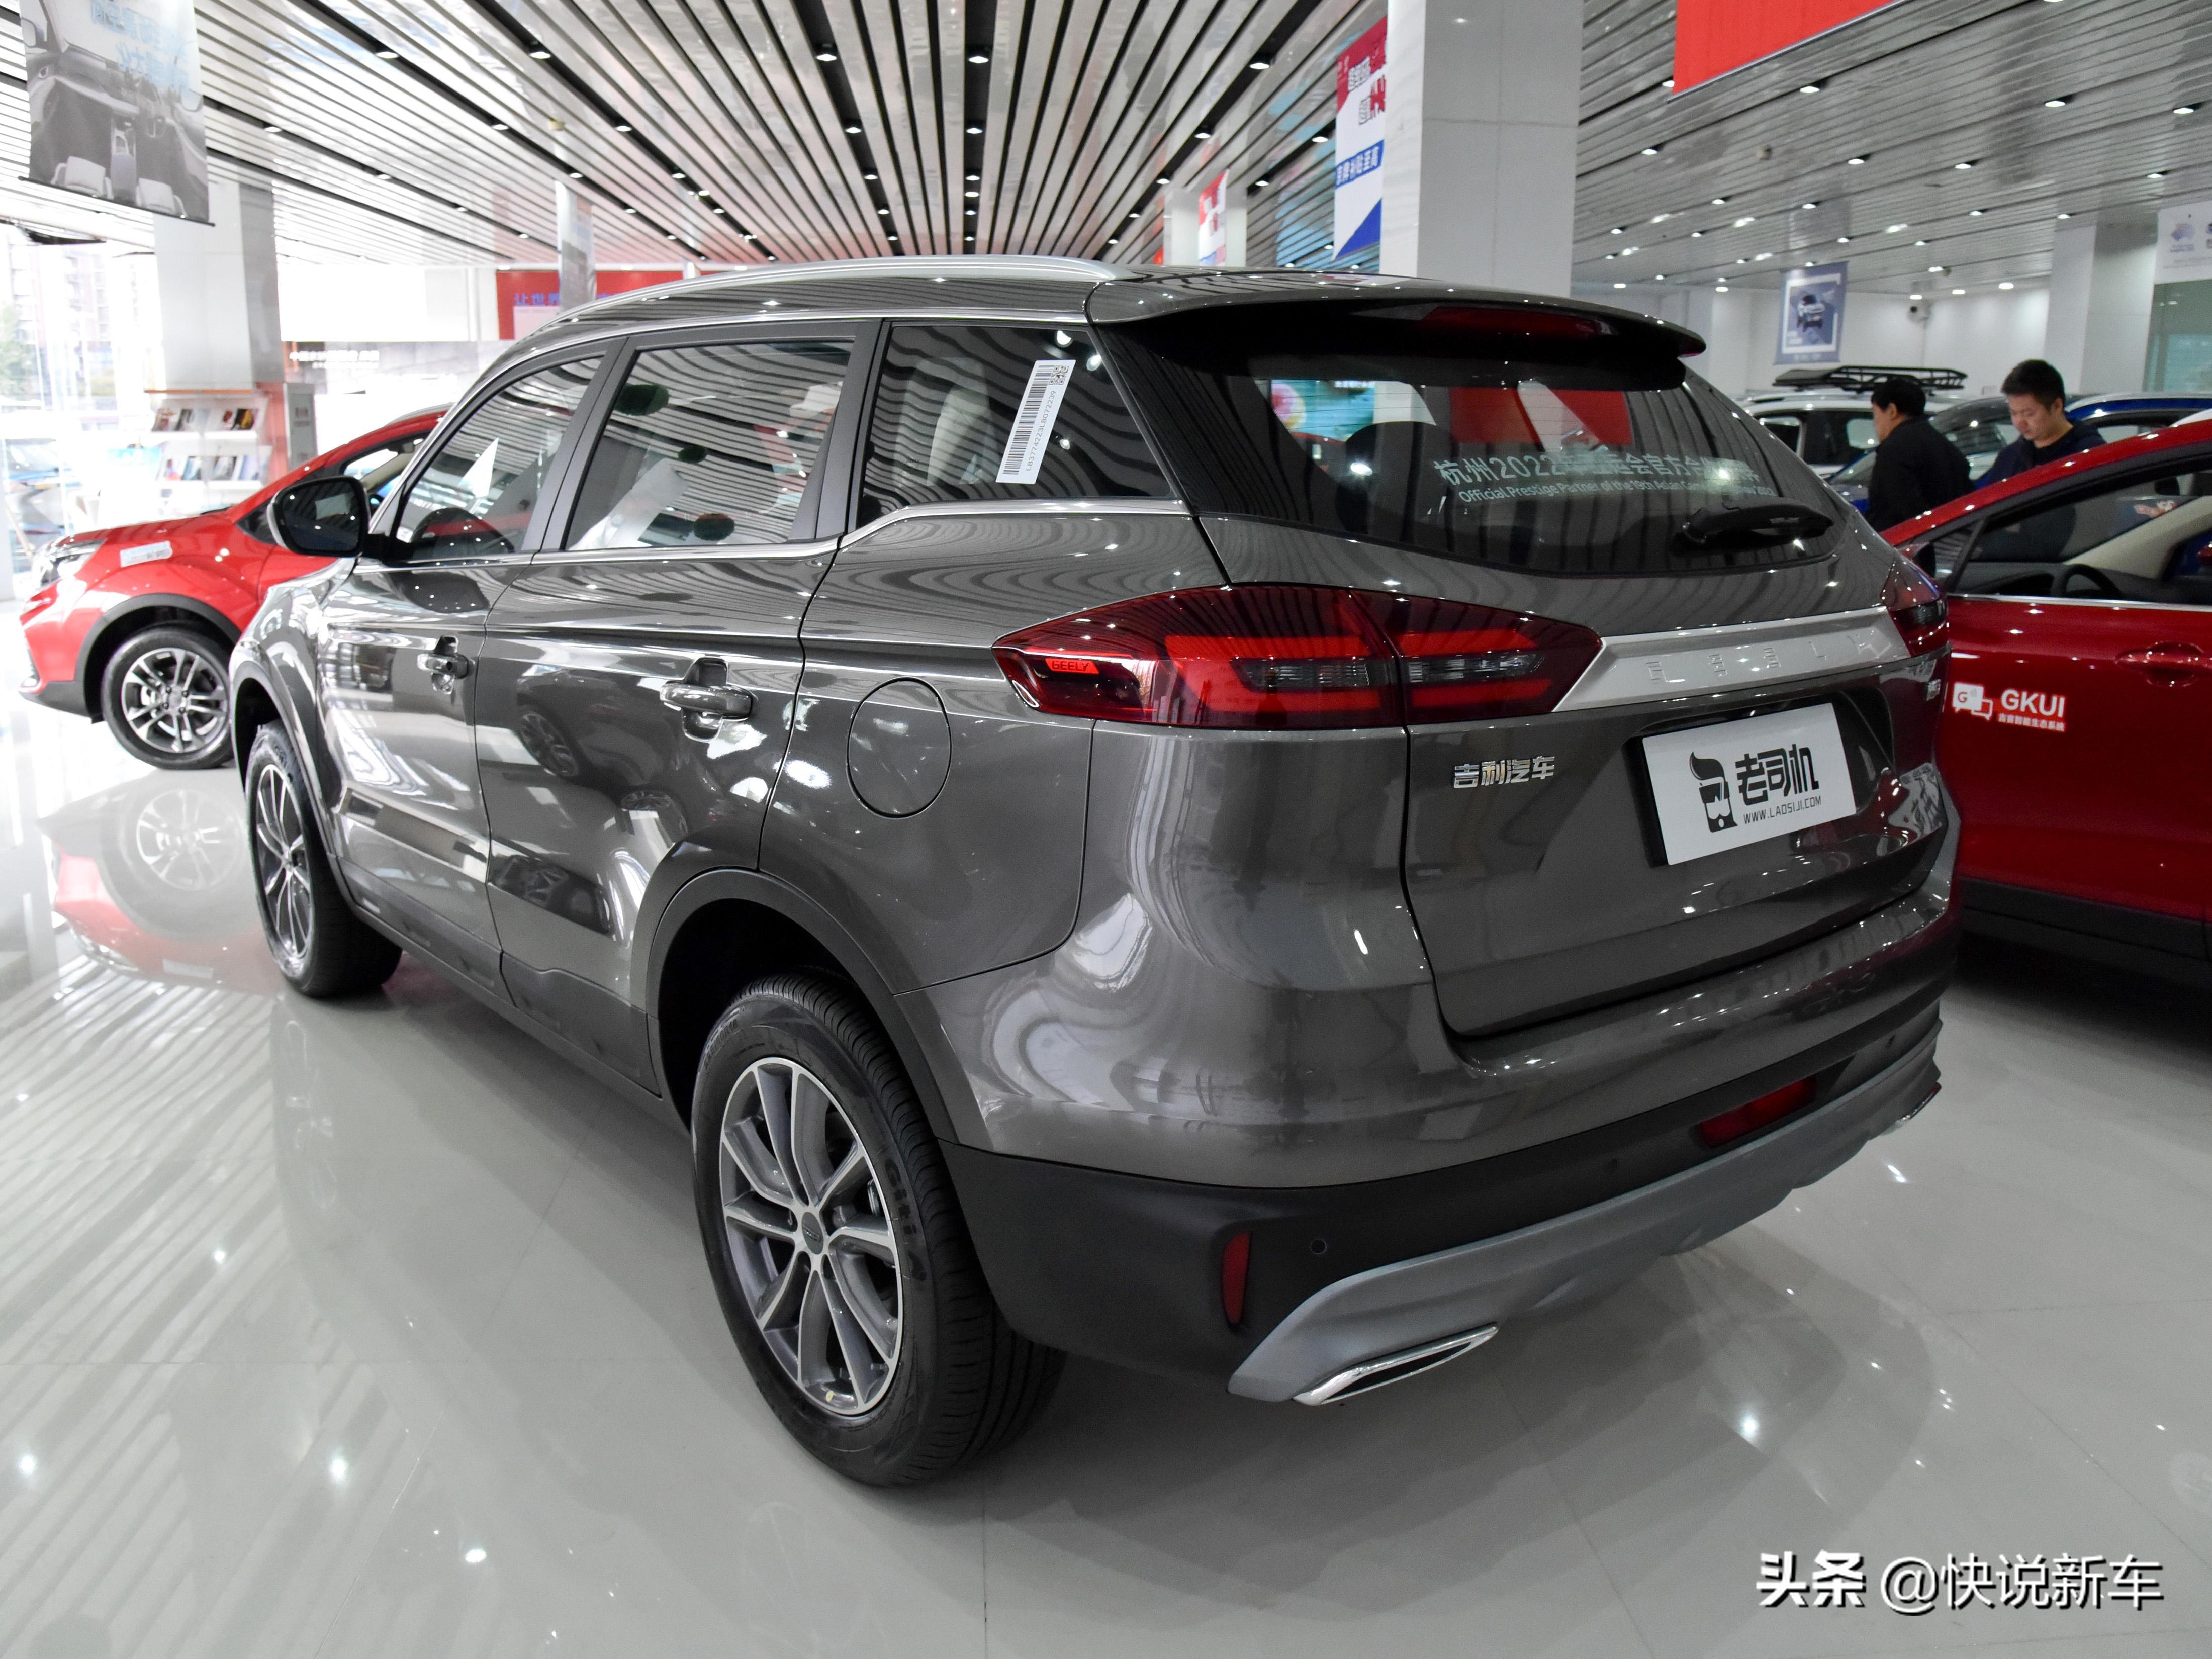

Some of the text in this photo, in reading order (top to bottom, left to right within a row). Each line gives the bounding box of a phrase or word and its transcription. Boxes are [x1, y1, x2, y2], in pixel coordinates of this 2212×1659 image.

[1026, 390, 1056, 471] LB37742Z3LB072239
[1458, 486, 1508, 503] Official
[1506, 483, 1561, 498] Prestige
[1557, 482, 1599, 495] Partner
[1051, 660, 1090, 672] GEELY
[2001, 688, 2065, 718] GKUI
[1453, 756, 1555, 789] 吉利汽车
[1734, 743, 1820, 806] 老司机
[1743, 795, 1822, 824] WWW.LAOSIJI.COM
[884, 1158, 917, 1235] Giti
